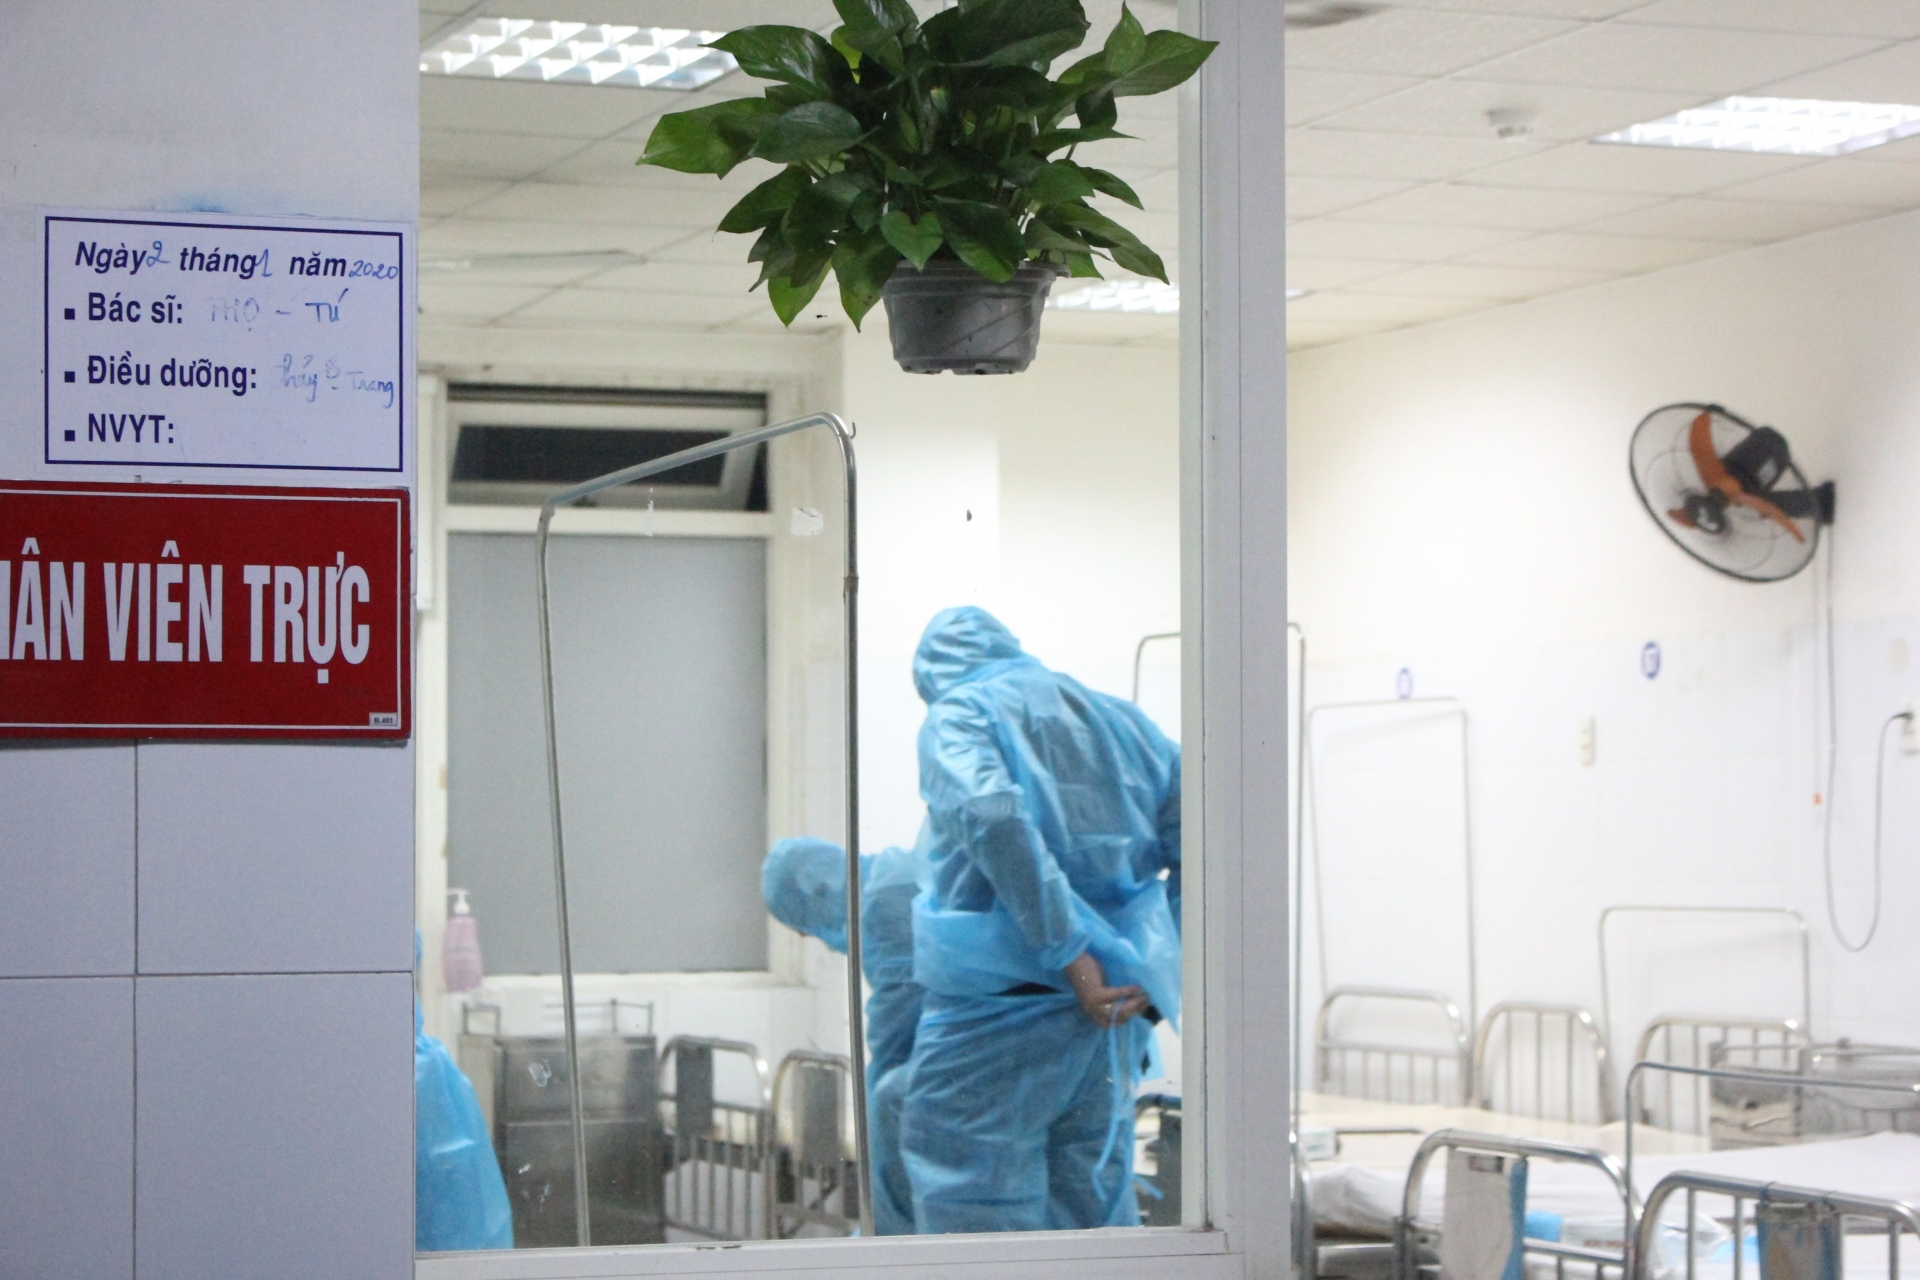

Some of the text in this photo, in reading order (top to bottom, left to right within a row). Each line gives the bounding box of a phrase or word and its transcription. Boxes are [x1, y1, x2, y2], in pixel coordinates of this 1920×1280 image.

[75, 240, 399, 280] Ngày 2 tháng 1 năm 2020
[88, 292, 141, 322] Bác
[151, 294, 183, 324] sĩ:
[87, 351, 150, 385] Điều
[160, 358, 257, 397] dưỡng:
[88, 413, 175, 444] NVYT:
[103, 540, 223, 662] VIÊN
[243, 551, 370, 684] TRỰC
